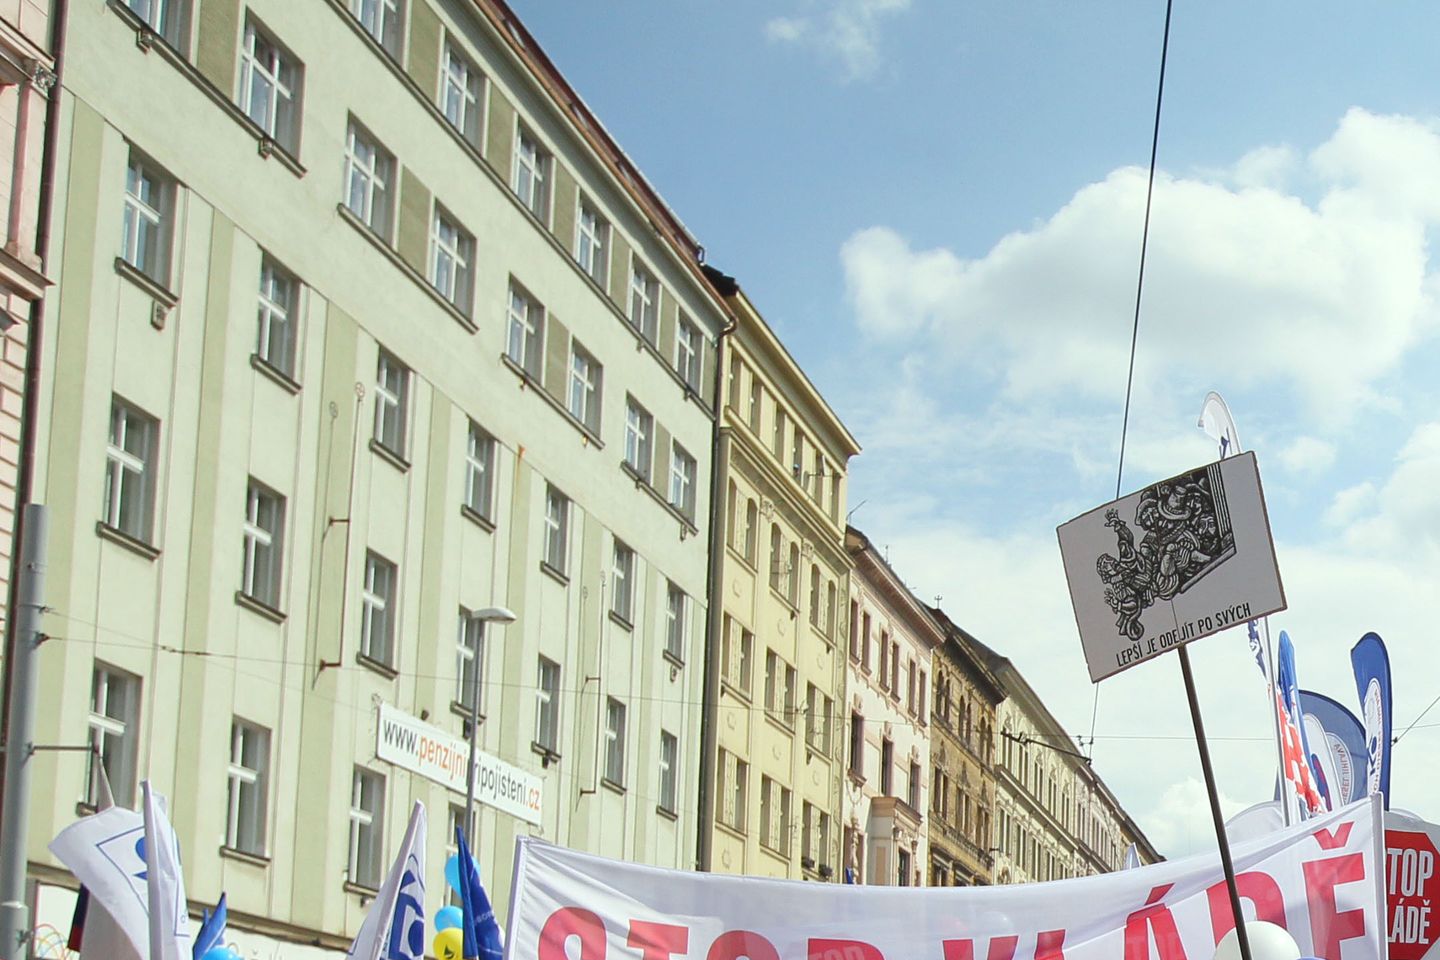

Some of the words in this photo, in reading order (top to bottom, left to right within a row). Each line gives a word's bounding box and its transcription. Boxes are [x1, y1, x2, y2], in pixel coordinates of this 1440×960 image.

[1116, 642, 1144, 667] LEPŠÍ
[1146, 637, 1158, 655] JE
[1159, 621, 1196, 649] ODEJÍT
[1198, 616, 1213, 634] PO
[1215, 602, 1252, 627] SVÝCH
[383, 719, 540, 811] www.penzijniripojisteni.cz
[1387, 898, 1433, 945] ÁDĚ
